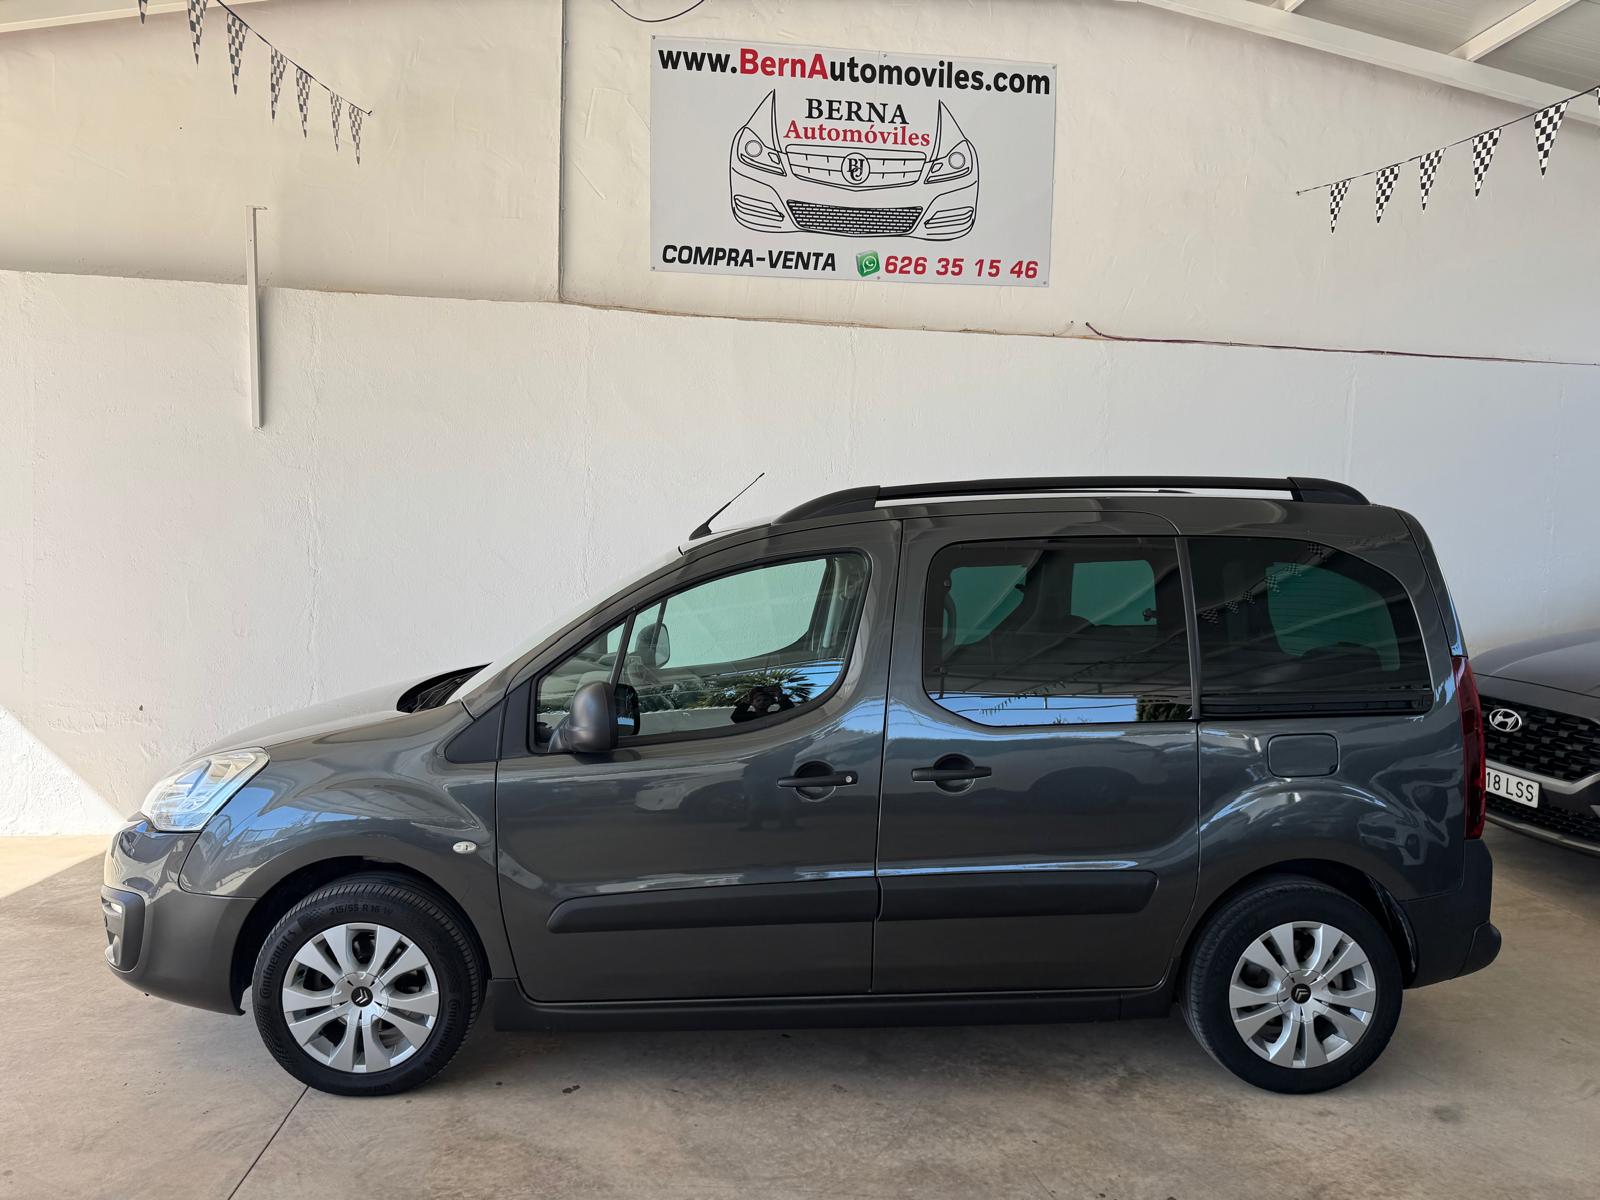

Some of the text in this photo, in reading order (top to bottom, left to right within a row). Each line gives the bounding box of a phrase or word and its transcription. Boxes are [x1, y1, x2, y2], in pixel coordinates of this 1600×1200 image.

[657, 47, 1051, 95] www.BernAutomoviles.com
[805, 98, 910, 125] BERNA
[783, 119, 931, 148] Automóviles
[662, 244, 837, 272] COMPRA-VENTA
[885, 255, 1039, 279] 626 35 15 46
[1505, 778, 1534, 802] LSS
